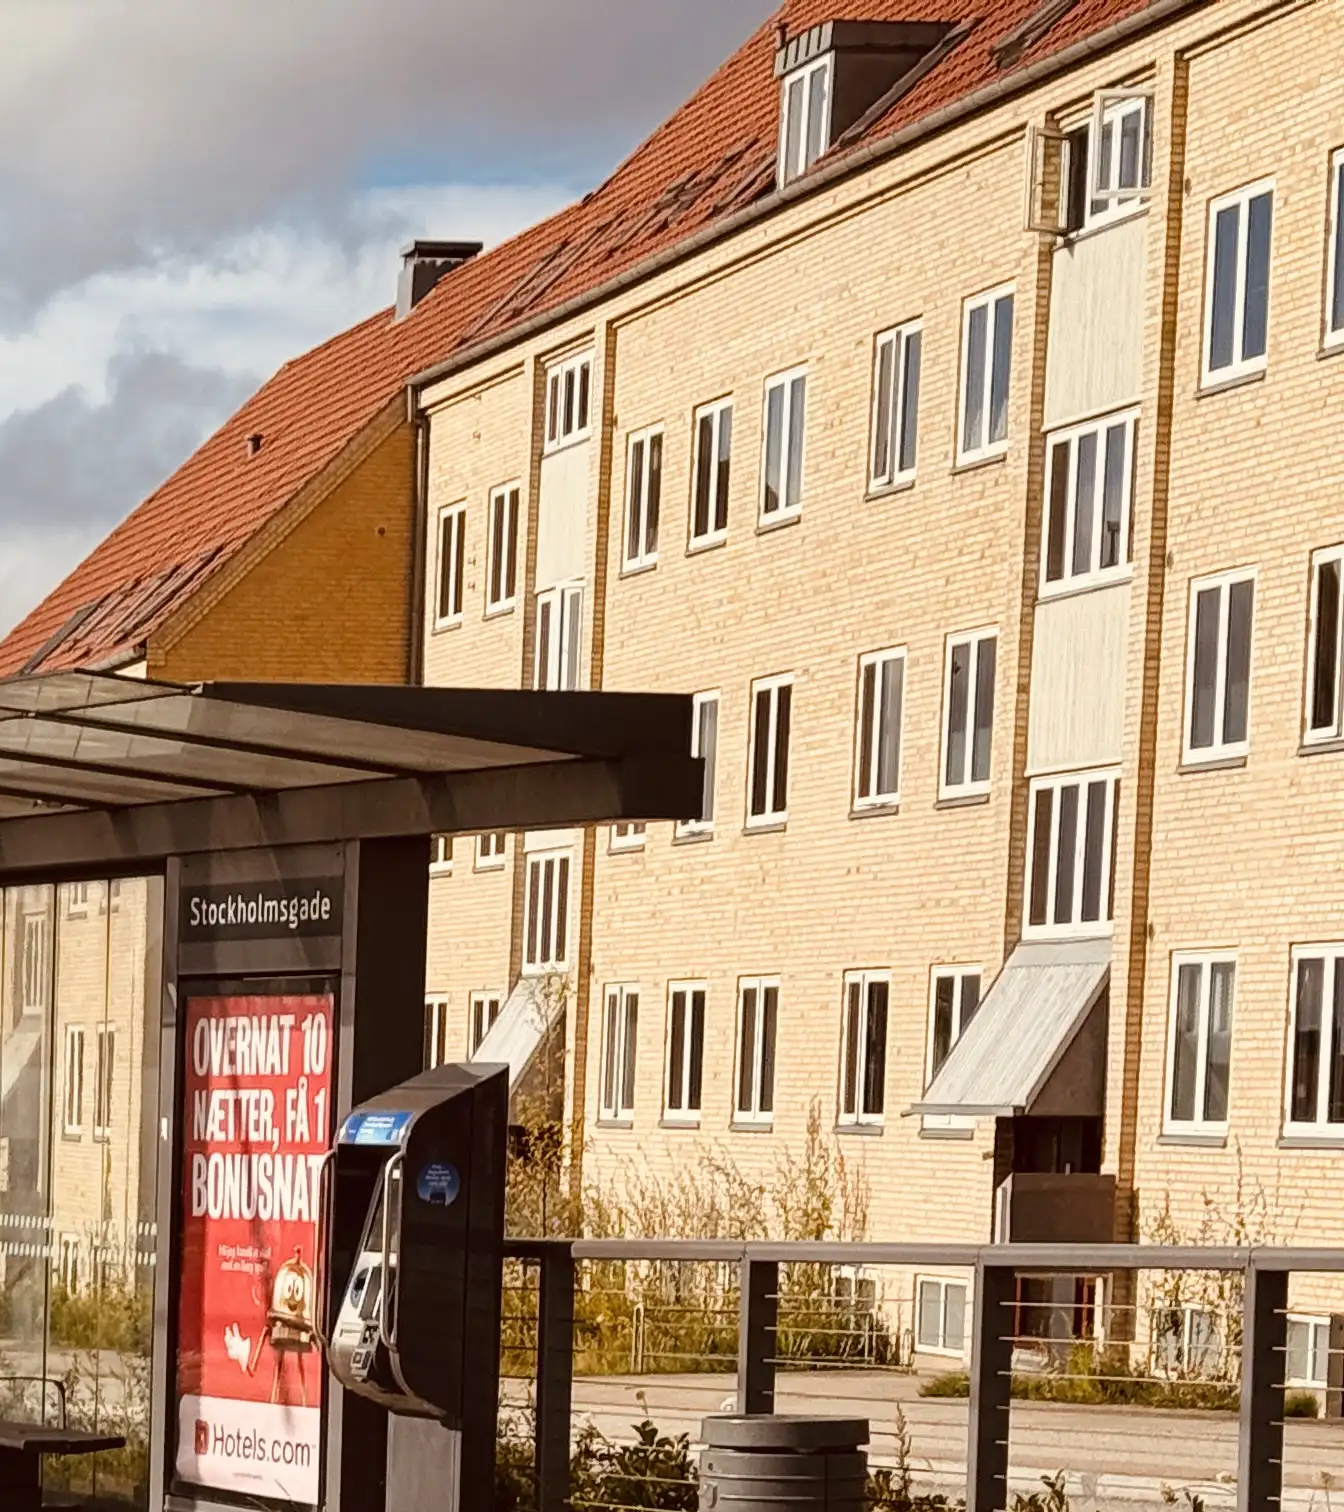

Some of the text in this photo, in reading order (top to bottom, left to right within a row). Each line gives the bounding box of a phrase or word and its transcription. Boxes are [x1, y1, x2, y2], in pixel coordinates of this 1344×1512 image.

[190, 890, 331, 929] Stockholmsgade
[193, 1012, 326, 1077] OVERNAT 10
[193, 1076, 326, 1152] NÆTTER, FÅ 1
[192, 1152, 324, 1222] BONUSNAT
[213, 1423, 311, 1468] Hotels.com
